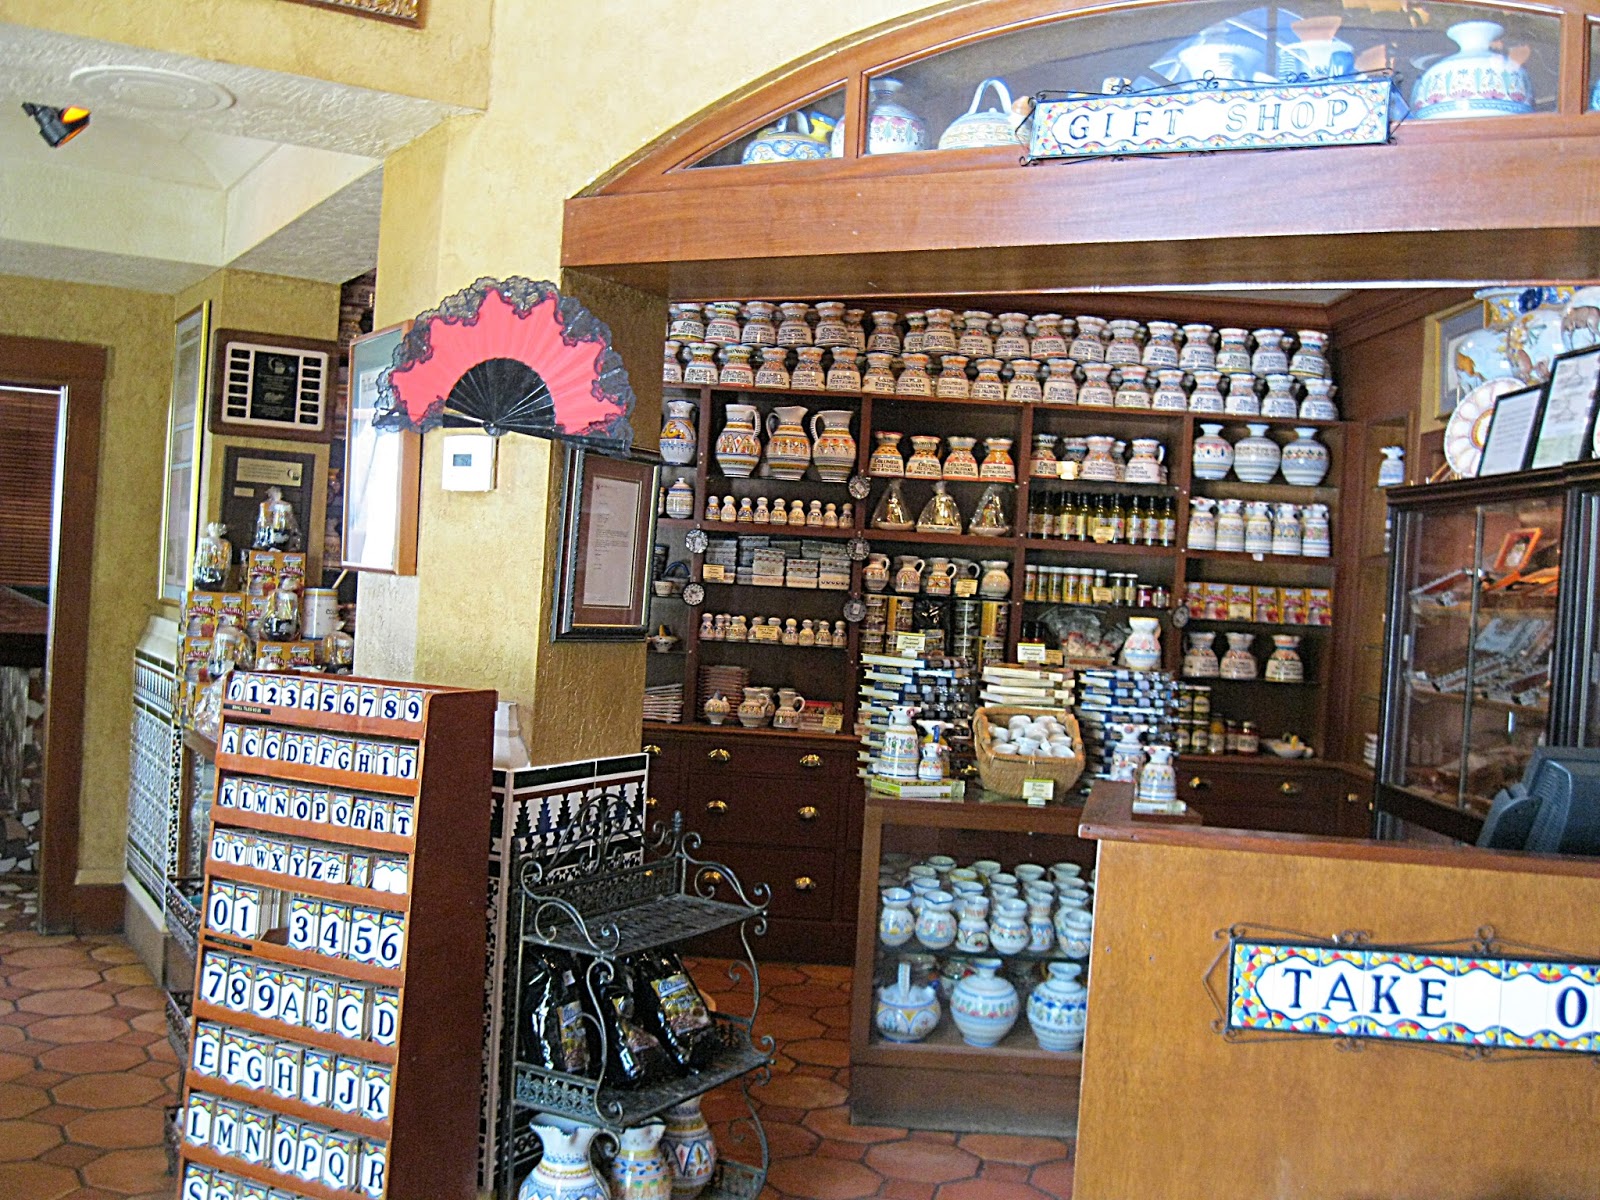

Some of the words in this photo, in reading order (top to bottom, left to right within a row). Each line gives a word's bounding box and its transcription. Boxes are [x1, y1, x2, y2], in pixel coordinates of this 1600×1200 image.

[1069, 108, 1184, 140] GIFT
[1226, 99, 1348, 133] SHOP
[1281, 967, 1447, 1019] TAKE
